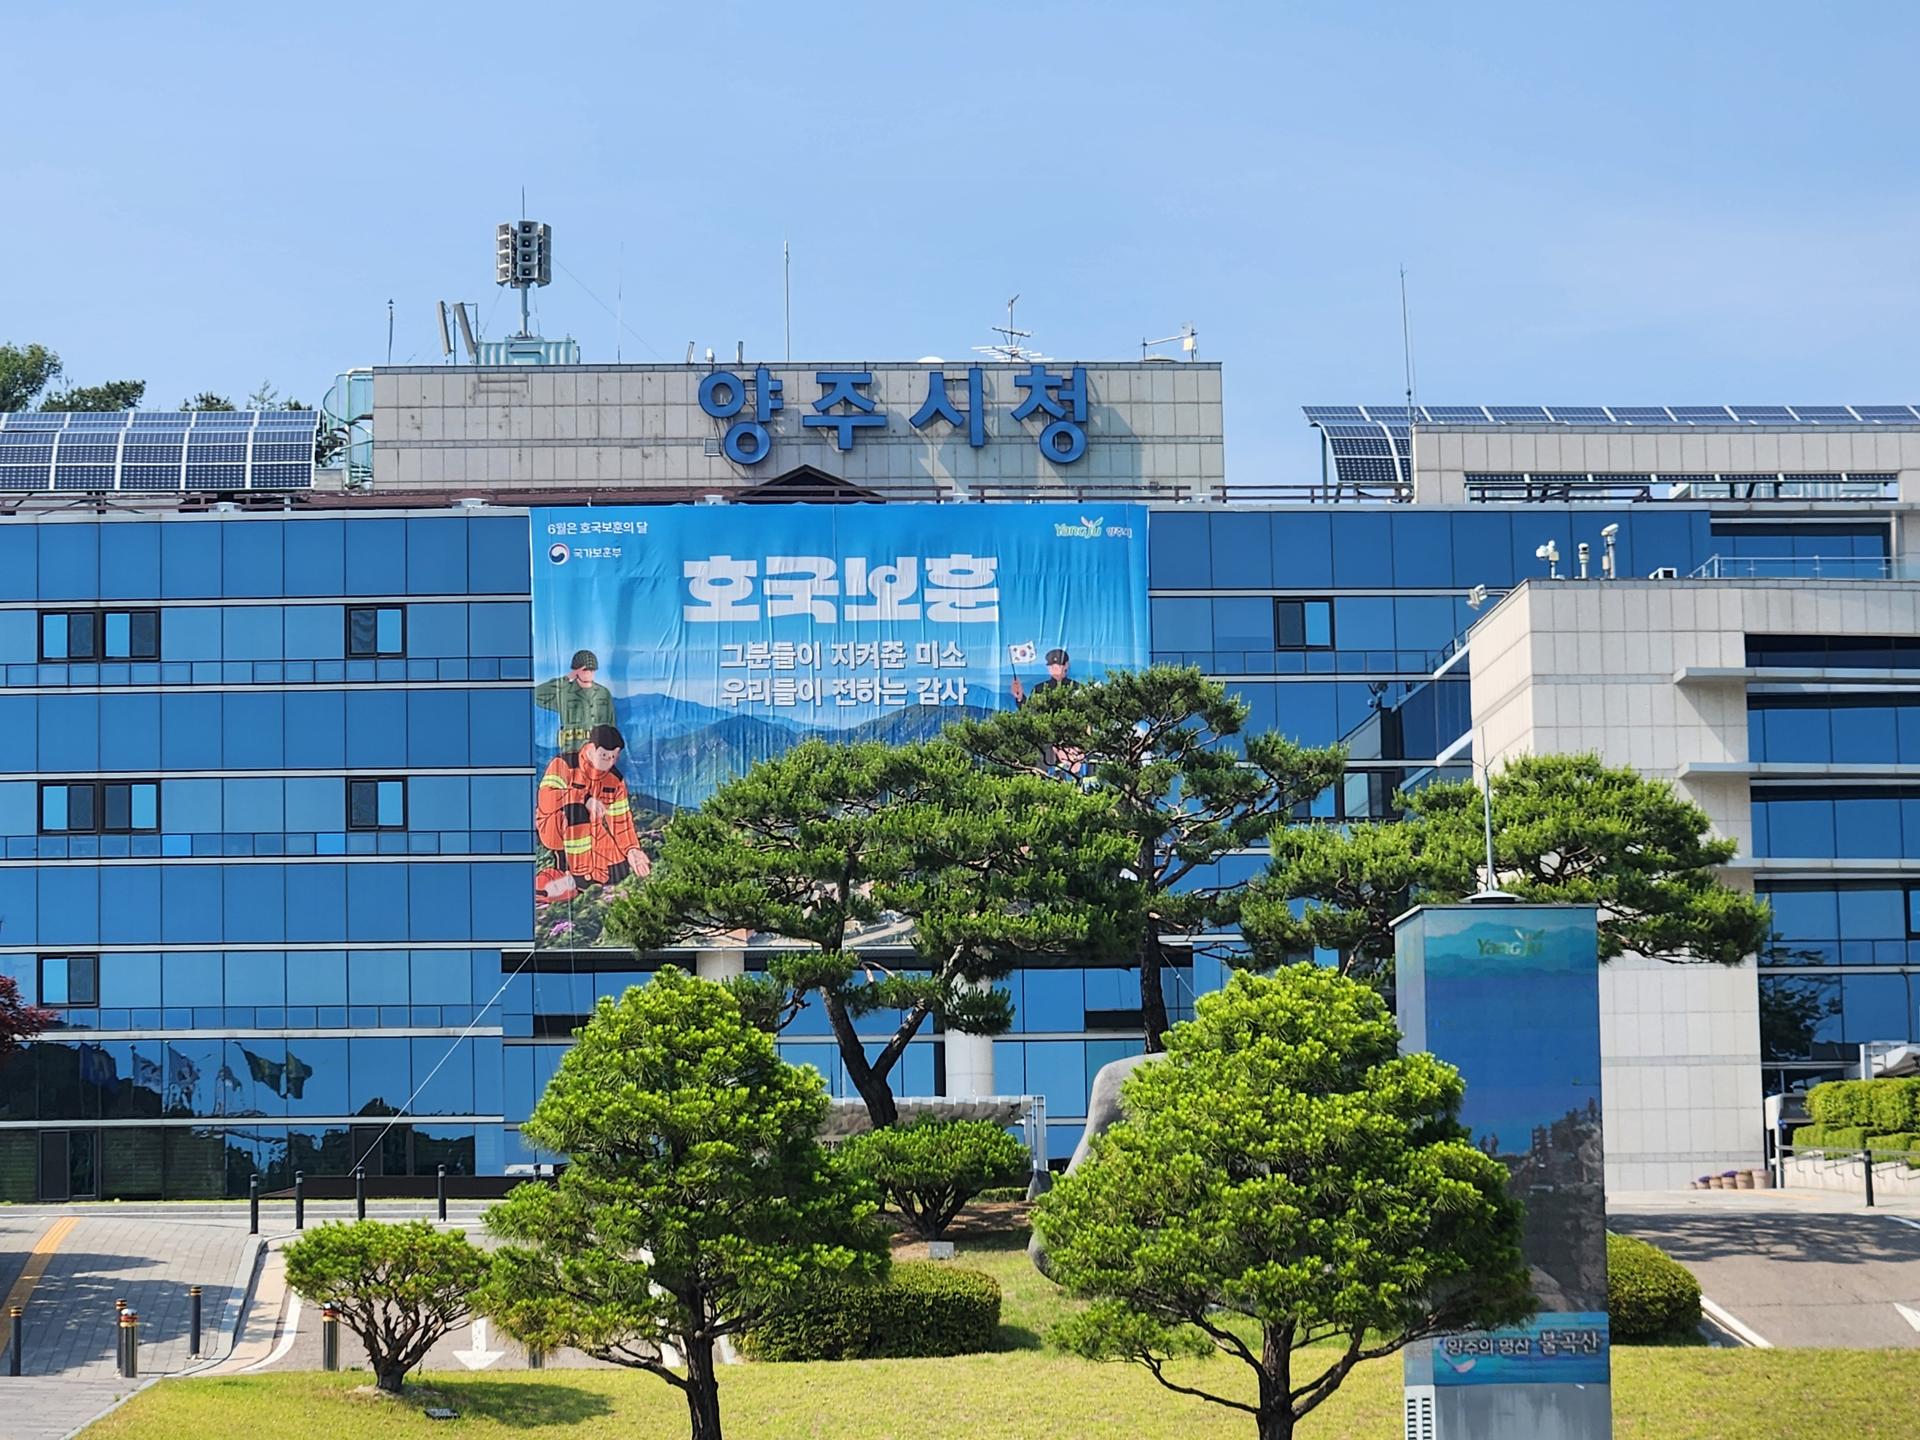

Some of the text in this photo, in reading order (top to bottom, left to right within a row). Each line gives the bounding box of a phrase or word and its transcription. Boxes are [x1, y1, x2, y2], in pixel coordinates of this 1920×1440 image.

[699, 364, 1087, 464] 양주시청
[547, 521, 648, 535] 6월은 호국보훈의 달
[573, 547, 622, 558] 국가보훈부
[683, 554, 999, 623] 호국보훈
[720, 641, 967, 670] 그분들이 지켜준 미소
[722, 678, 967, 706] 우리들이 전하는 감사
[1539, 1330, 1600, 1355] 불곡산
